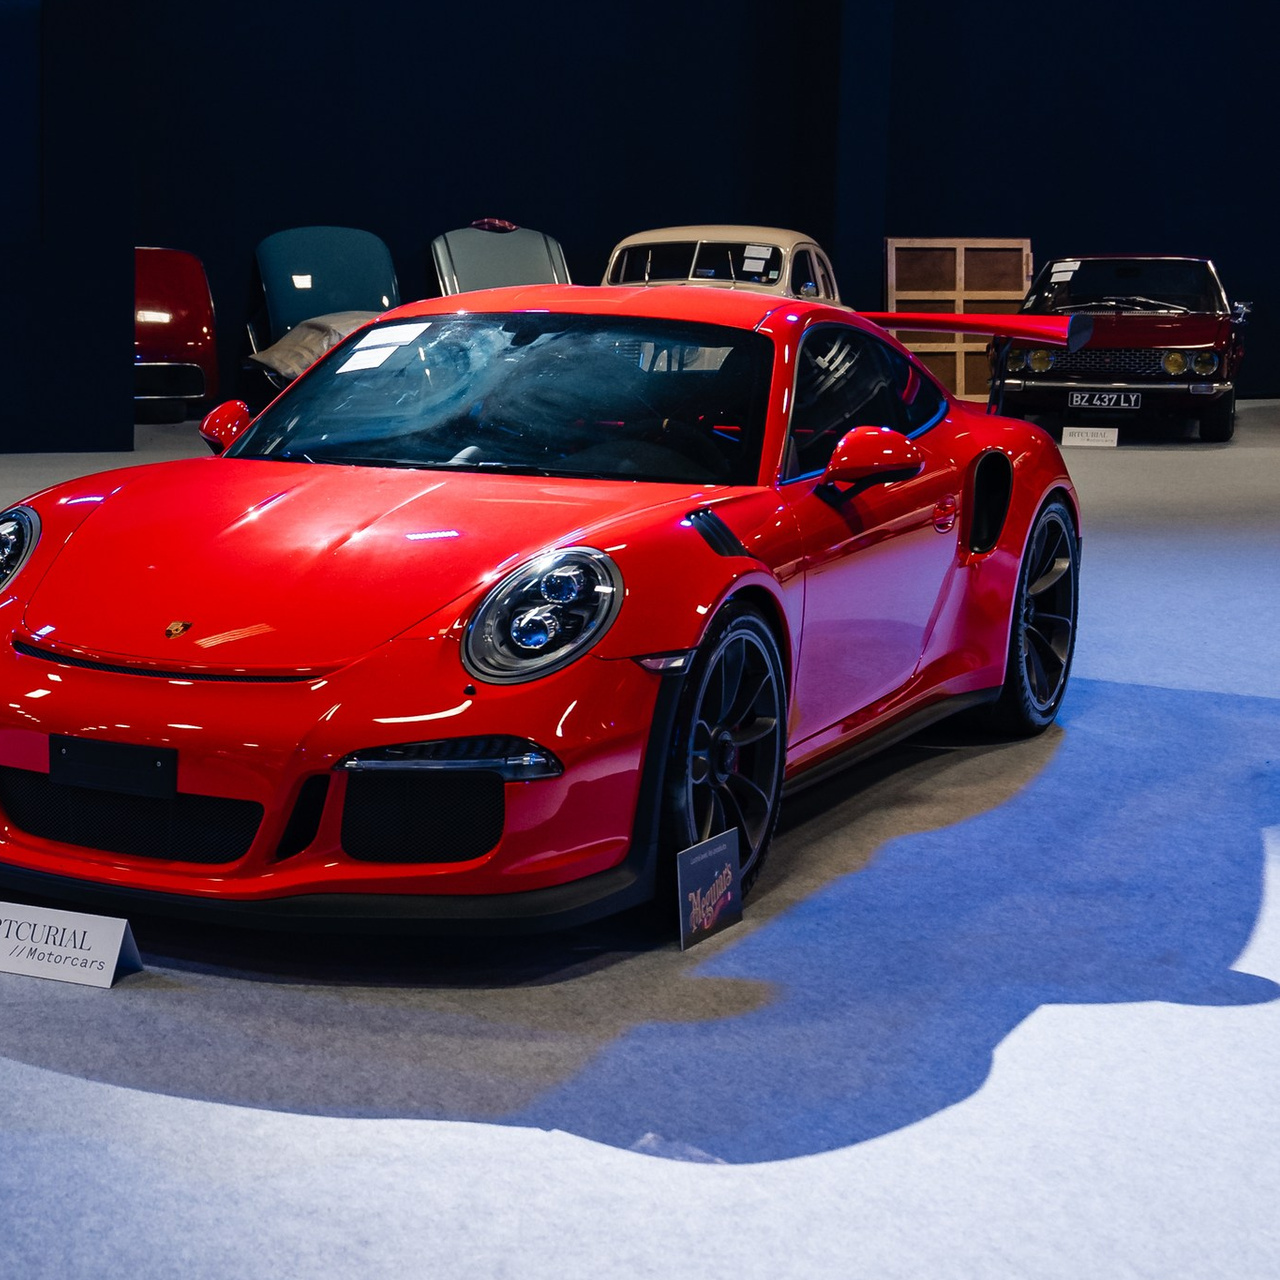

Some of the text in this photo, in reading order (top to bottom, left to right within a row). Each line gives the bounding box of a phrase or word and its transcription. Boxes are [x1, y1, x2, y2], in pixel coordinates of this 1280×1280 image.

[1072, 393, 1137, 407] BZ 437 LY
